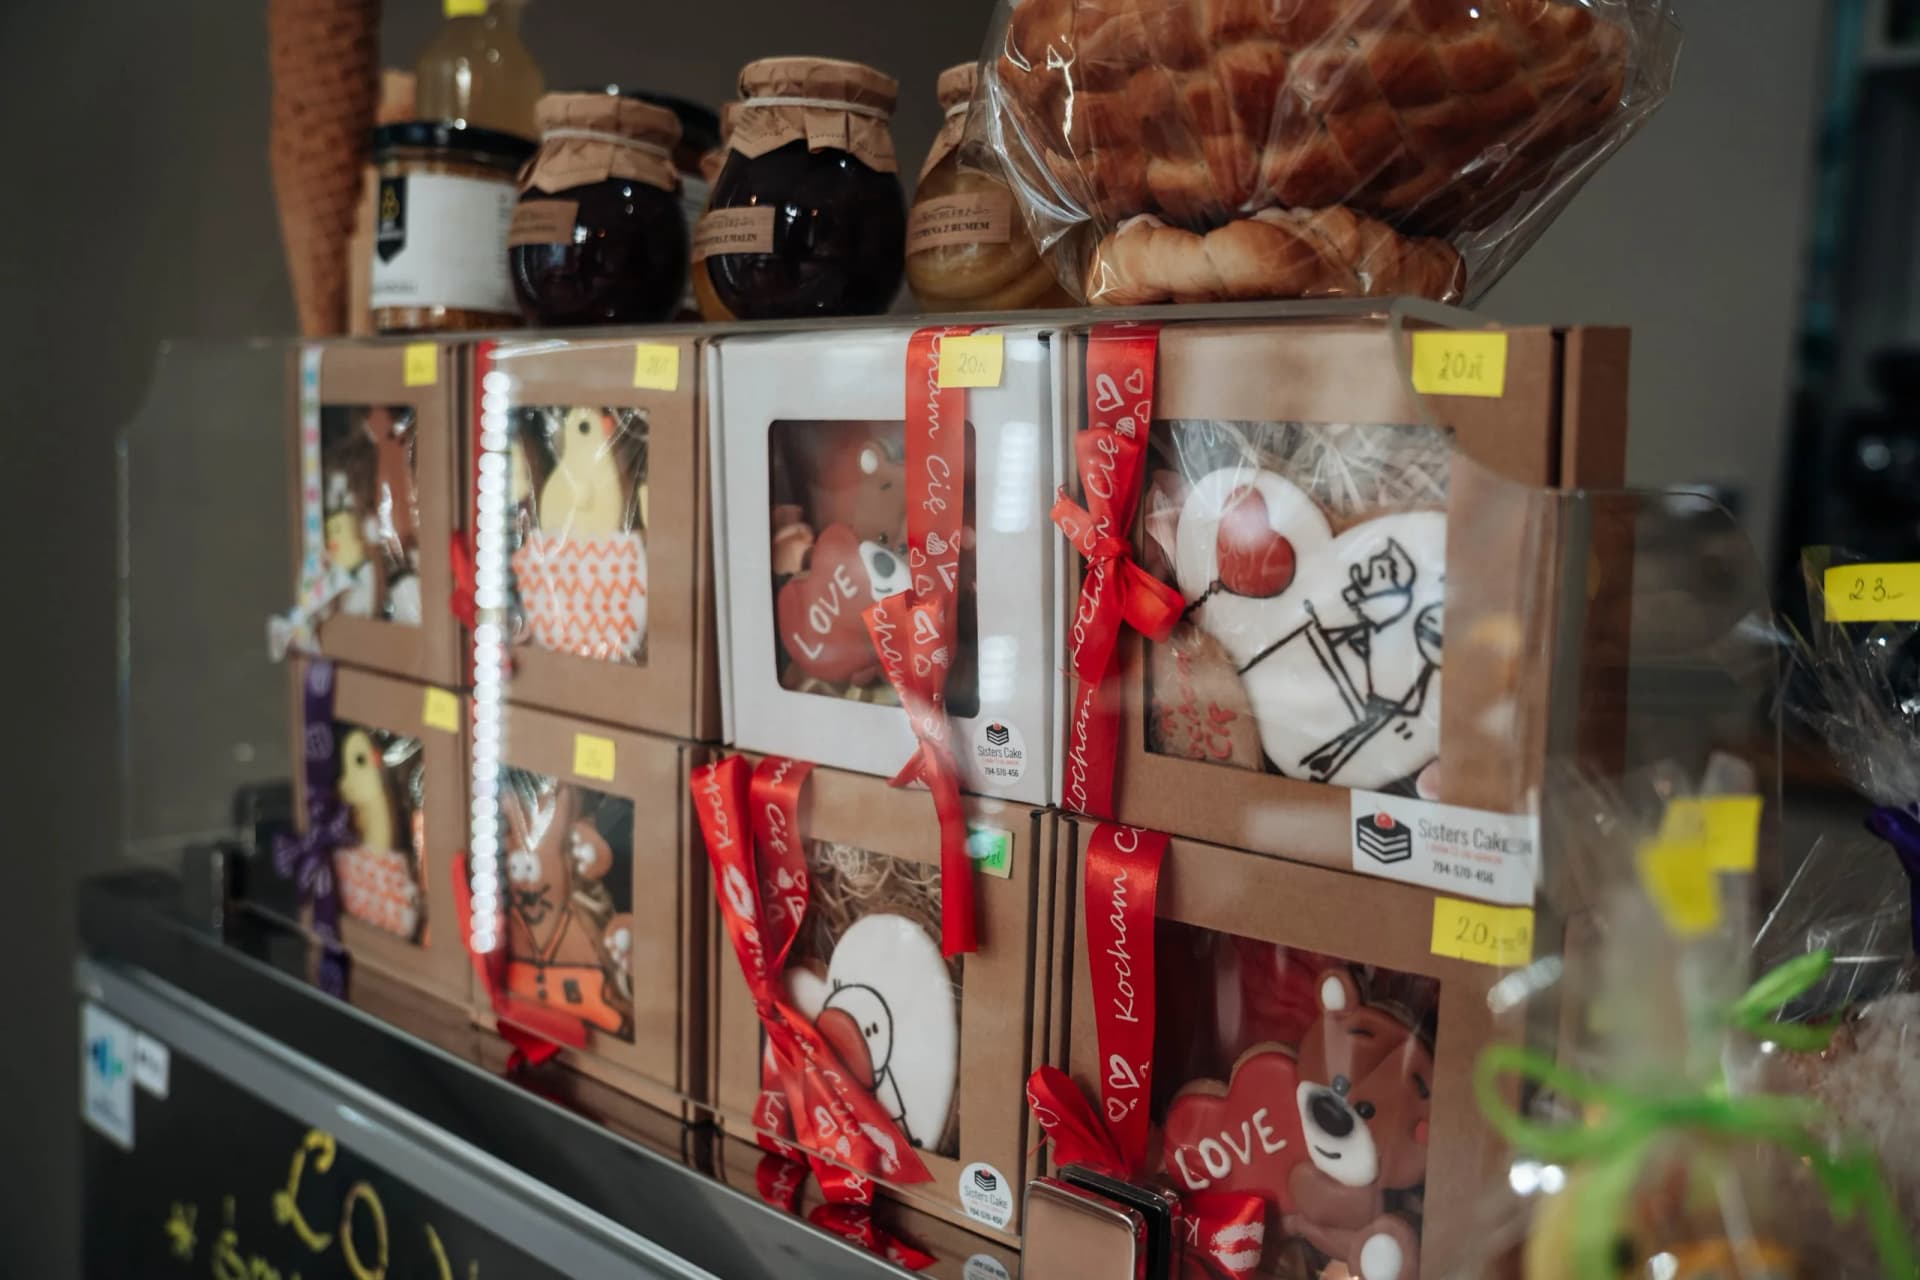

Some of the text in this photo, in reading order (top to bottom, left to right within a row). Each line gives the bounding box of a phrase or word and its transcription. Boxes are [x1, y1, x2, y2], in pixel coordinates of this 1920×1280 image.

[793, 564, 858, 660] LOVE
[977, 745, 1023, 760] Sisters Cake
[1418, 818, 1469, 848] Sisters
[1106, 867, 1139, 1022] Kocham
[1174, 1107, 1288, 1190] LOVE
